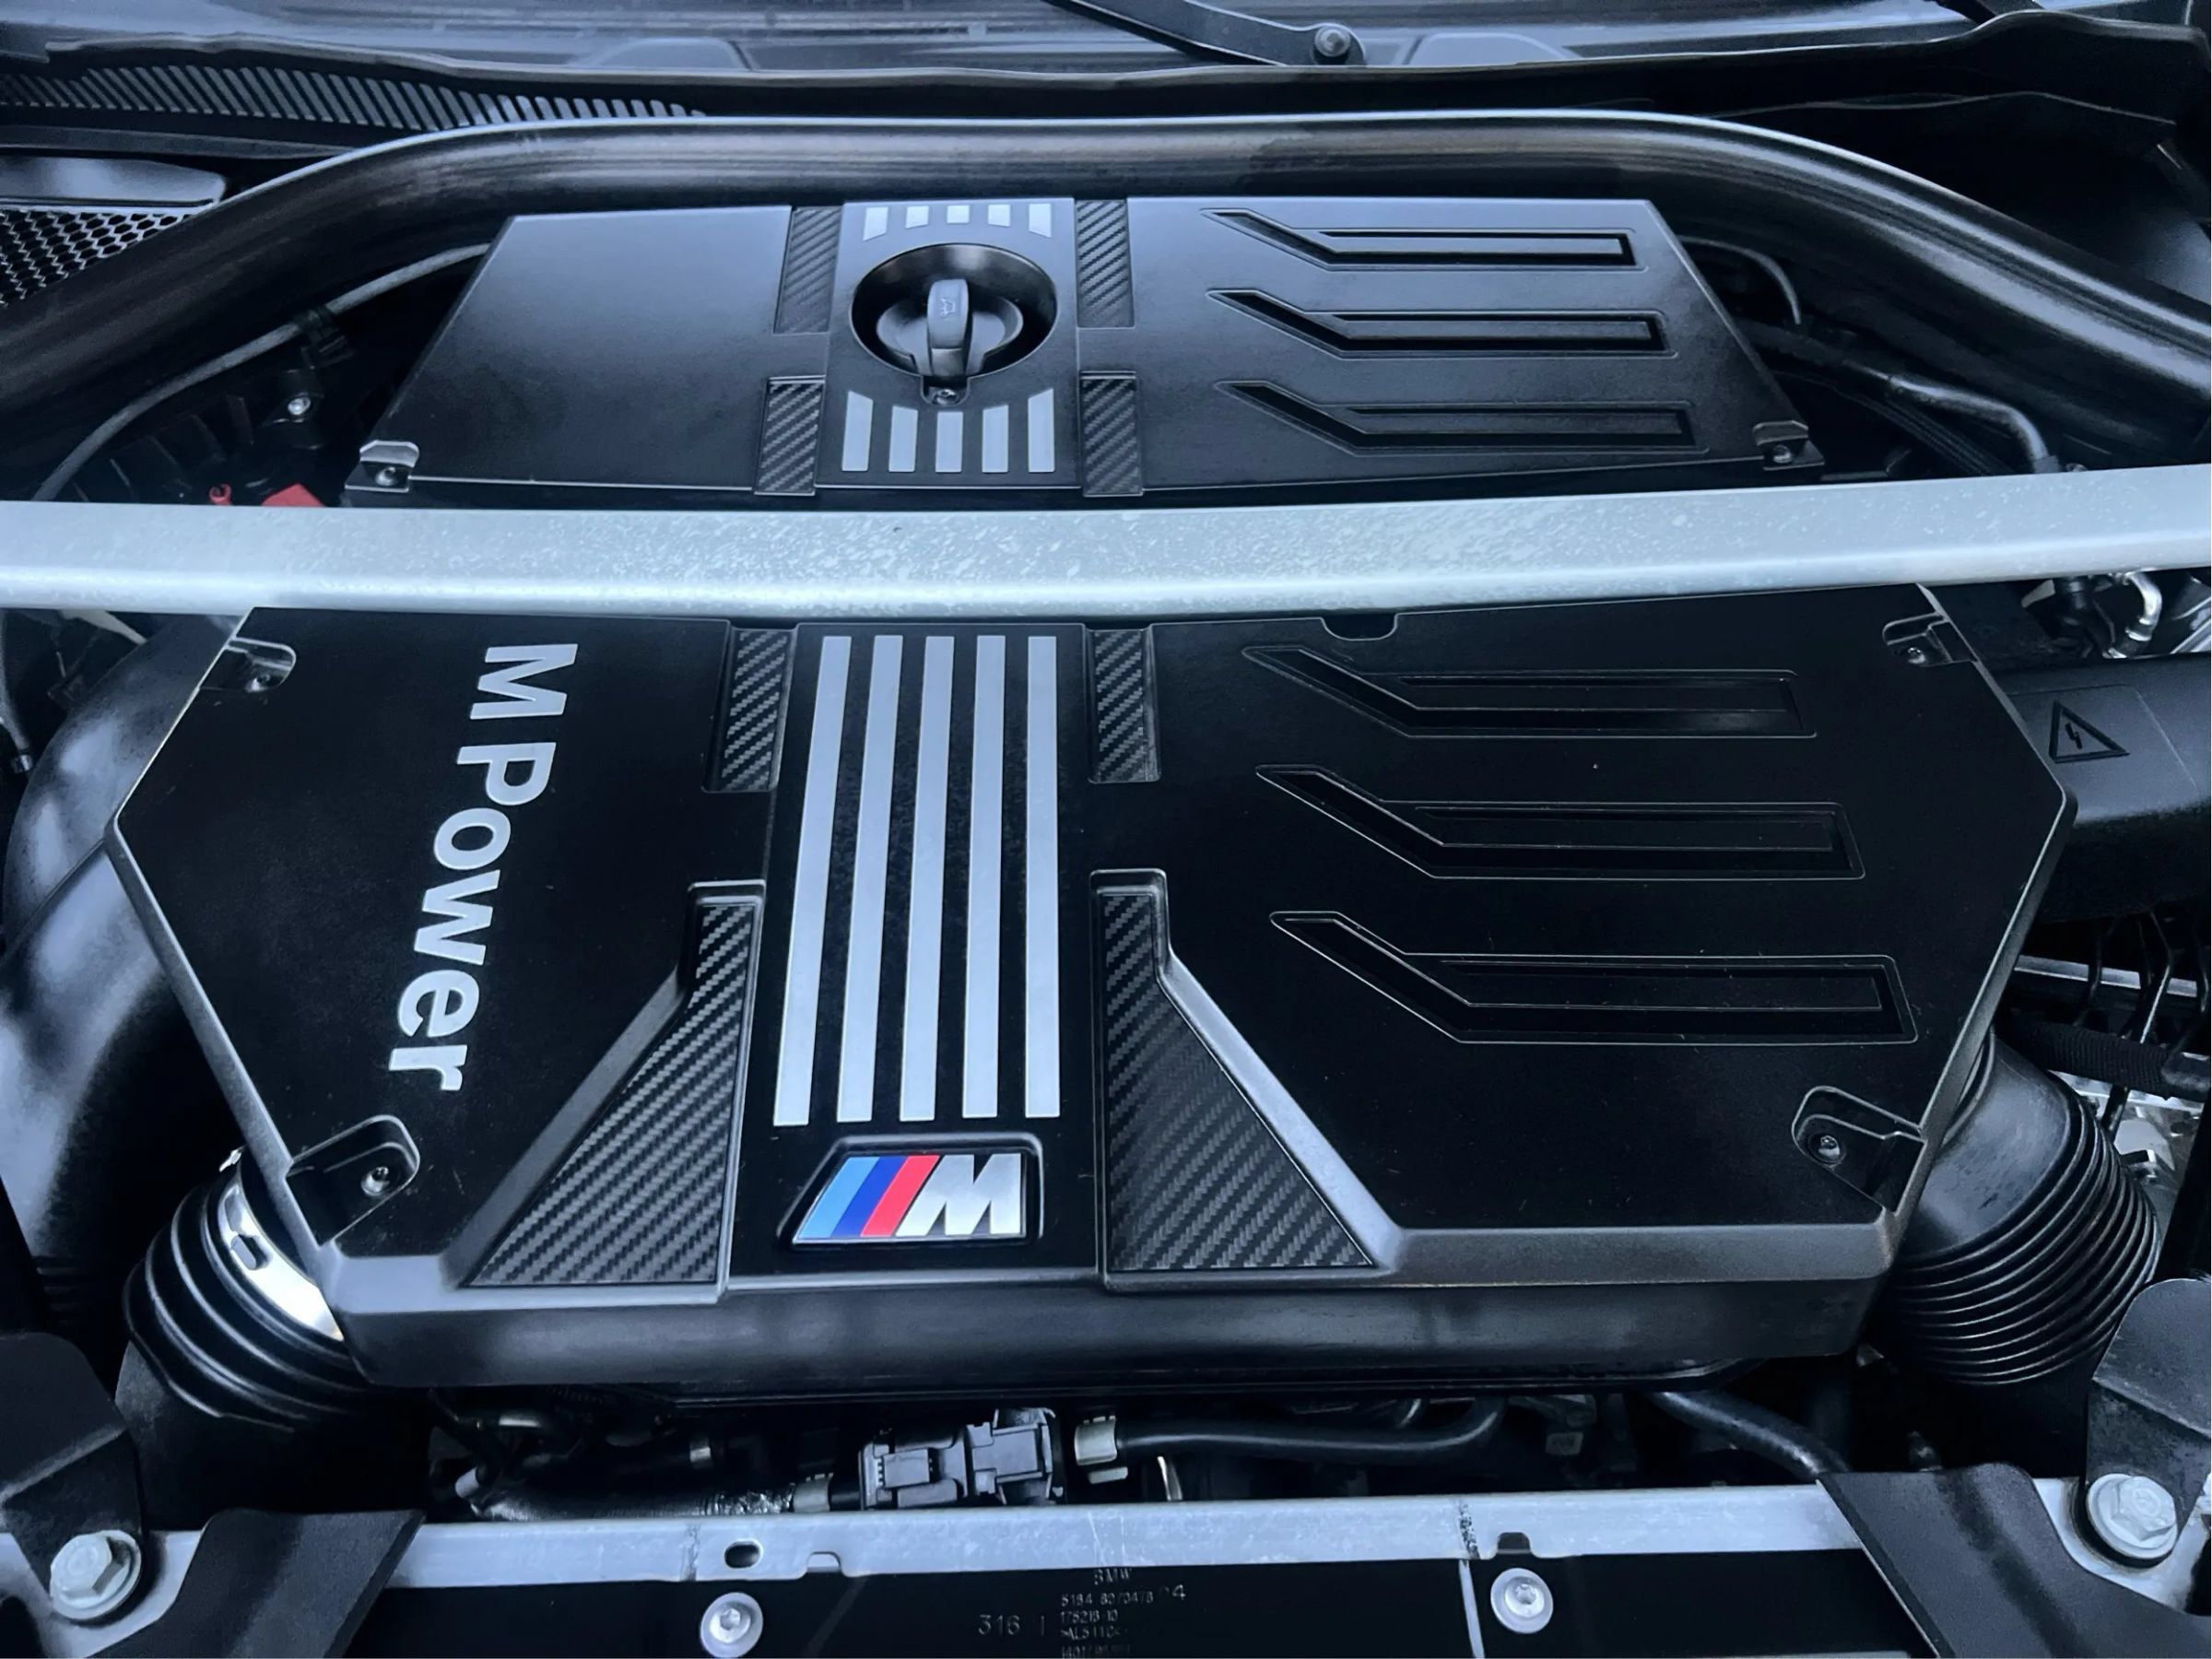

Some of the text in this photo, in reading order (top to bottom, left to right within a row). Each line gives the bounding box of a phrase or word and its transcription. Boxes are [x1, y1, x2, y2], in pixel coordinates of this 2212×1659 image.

[388, 643, 578, 1091] M Power
[895, 1152, 1022, 1237] M
[977, 1614, 1020, 1636] 316
